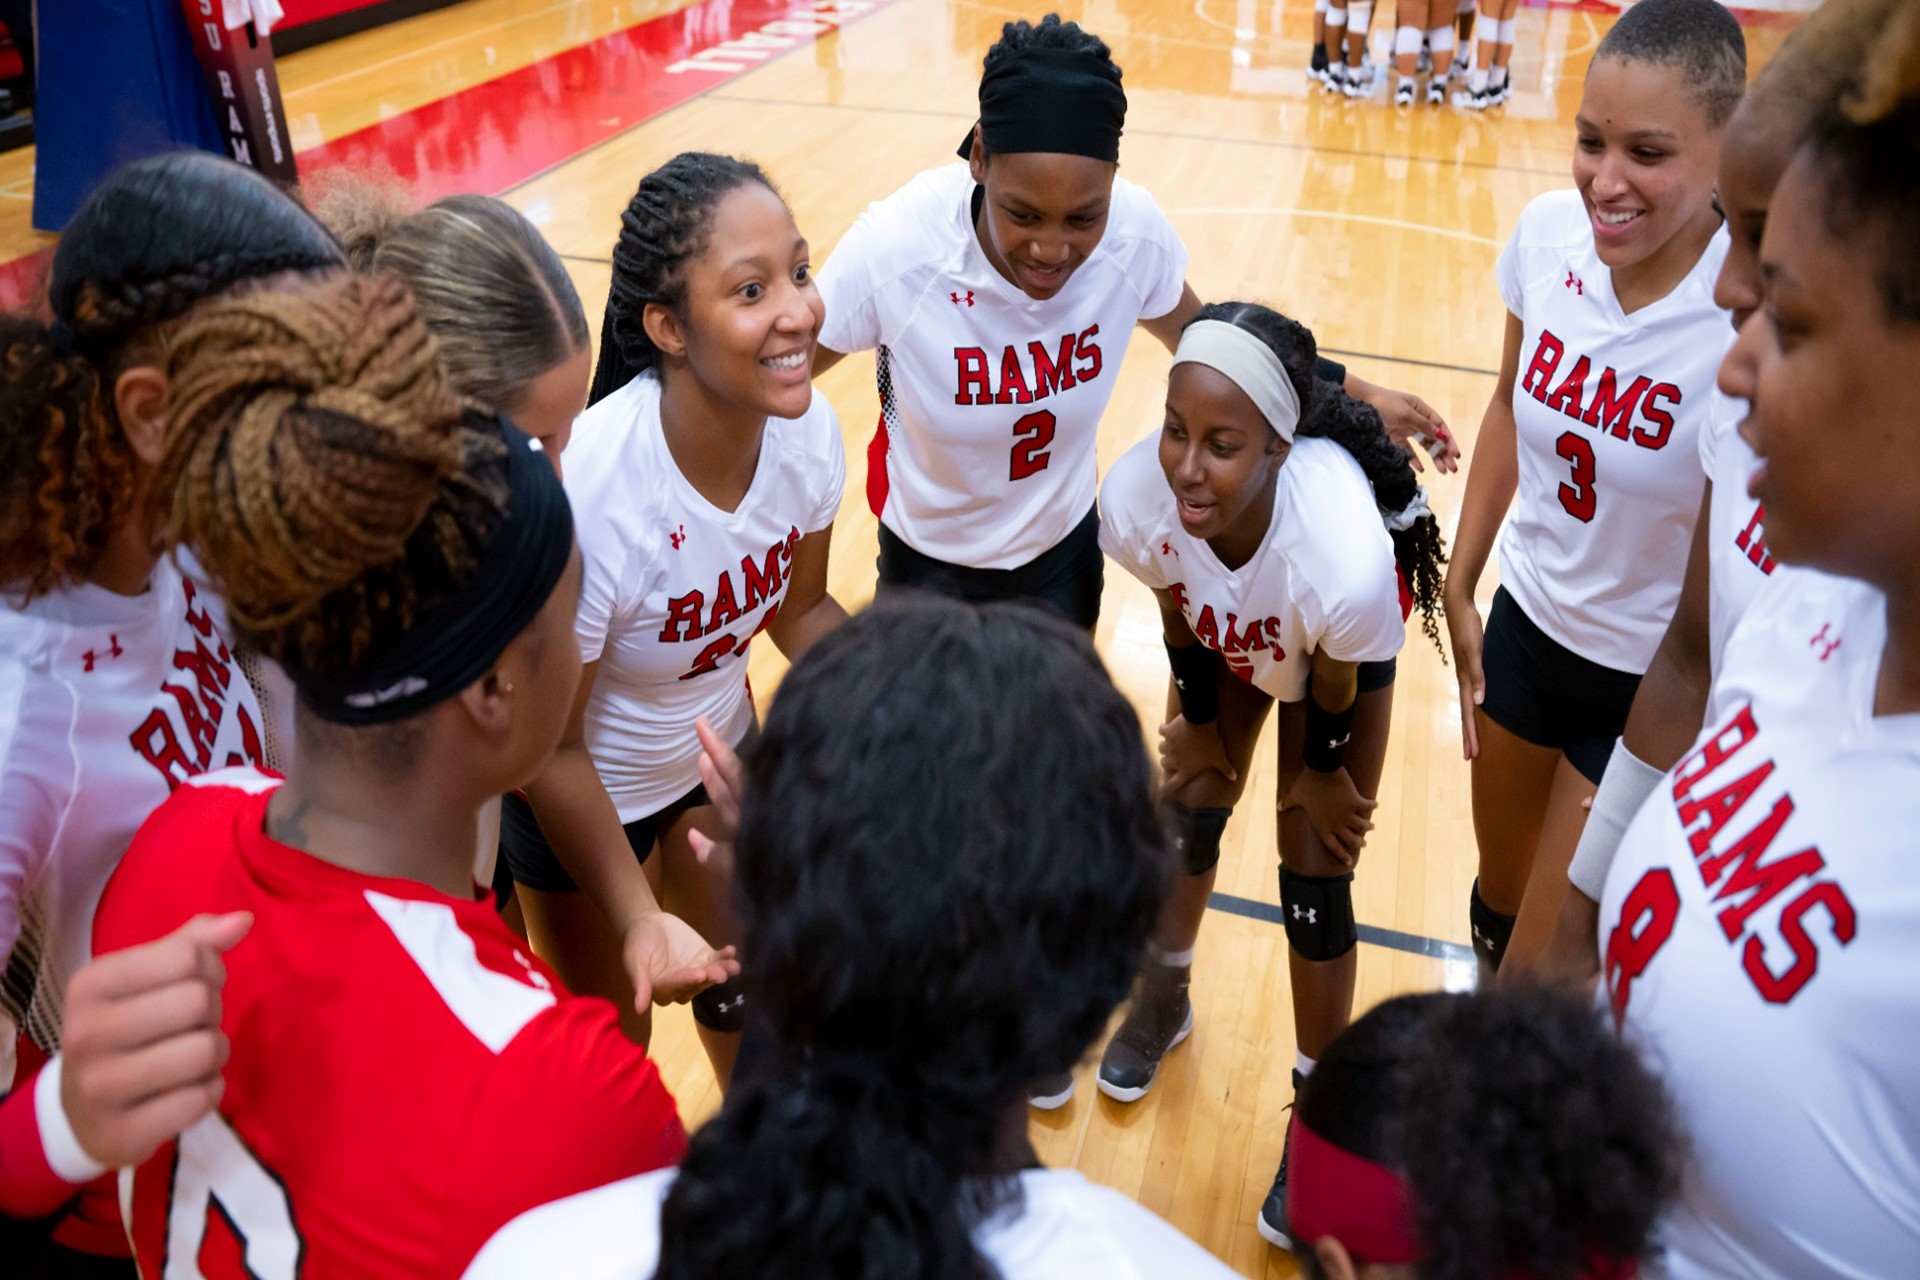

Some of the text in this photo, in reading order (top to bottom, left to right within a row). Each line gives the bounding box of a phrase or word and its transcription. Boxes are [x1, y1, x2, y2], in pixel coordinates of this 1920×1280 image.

[217, 69, 253, 166] RAM
[953, 322, 1103, 406] RAMS
[1521, 328, 1683, 451] RAMS
[1009, 408, 1057, 482] 2
[1555, 430, 1597, 524] 3
[1672, 701, 1857, 1007] RAMS
